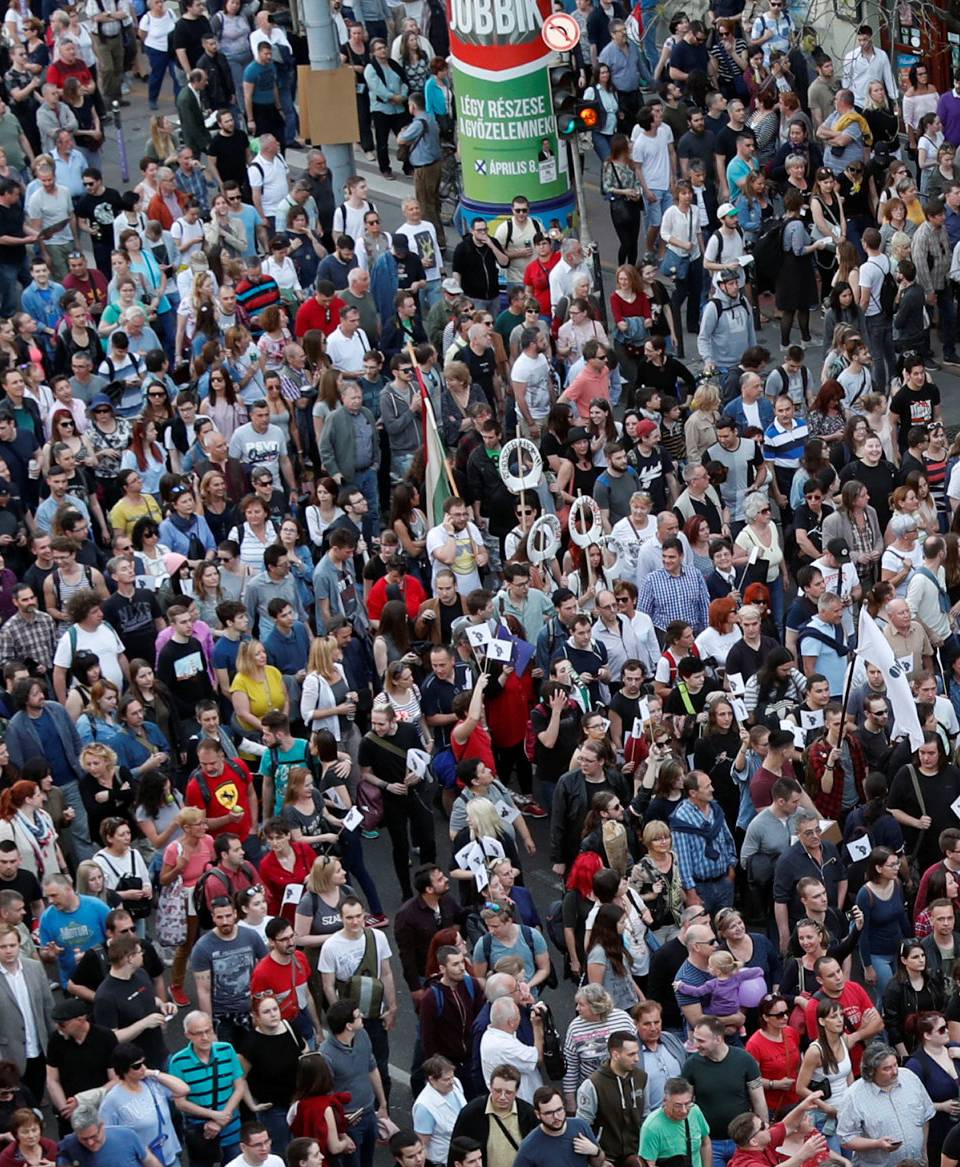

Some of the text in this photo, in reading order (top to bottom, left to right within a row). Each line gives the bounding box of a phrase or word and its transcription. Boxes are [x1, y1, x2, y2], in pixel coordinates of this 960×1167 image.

[450, 0, 543, 34] JOBBIK
[460, 94, 545, 119] LÉGY RÉSZESE
[465, 115, 555, 140] GYŐZELEMNEK!
[489, 159, 528, 177] ÁPRILIS
[528, 159, 540, 174] 8.
